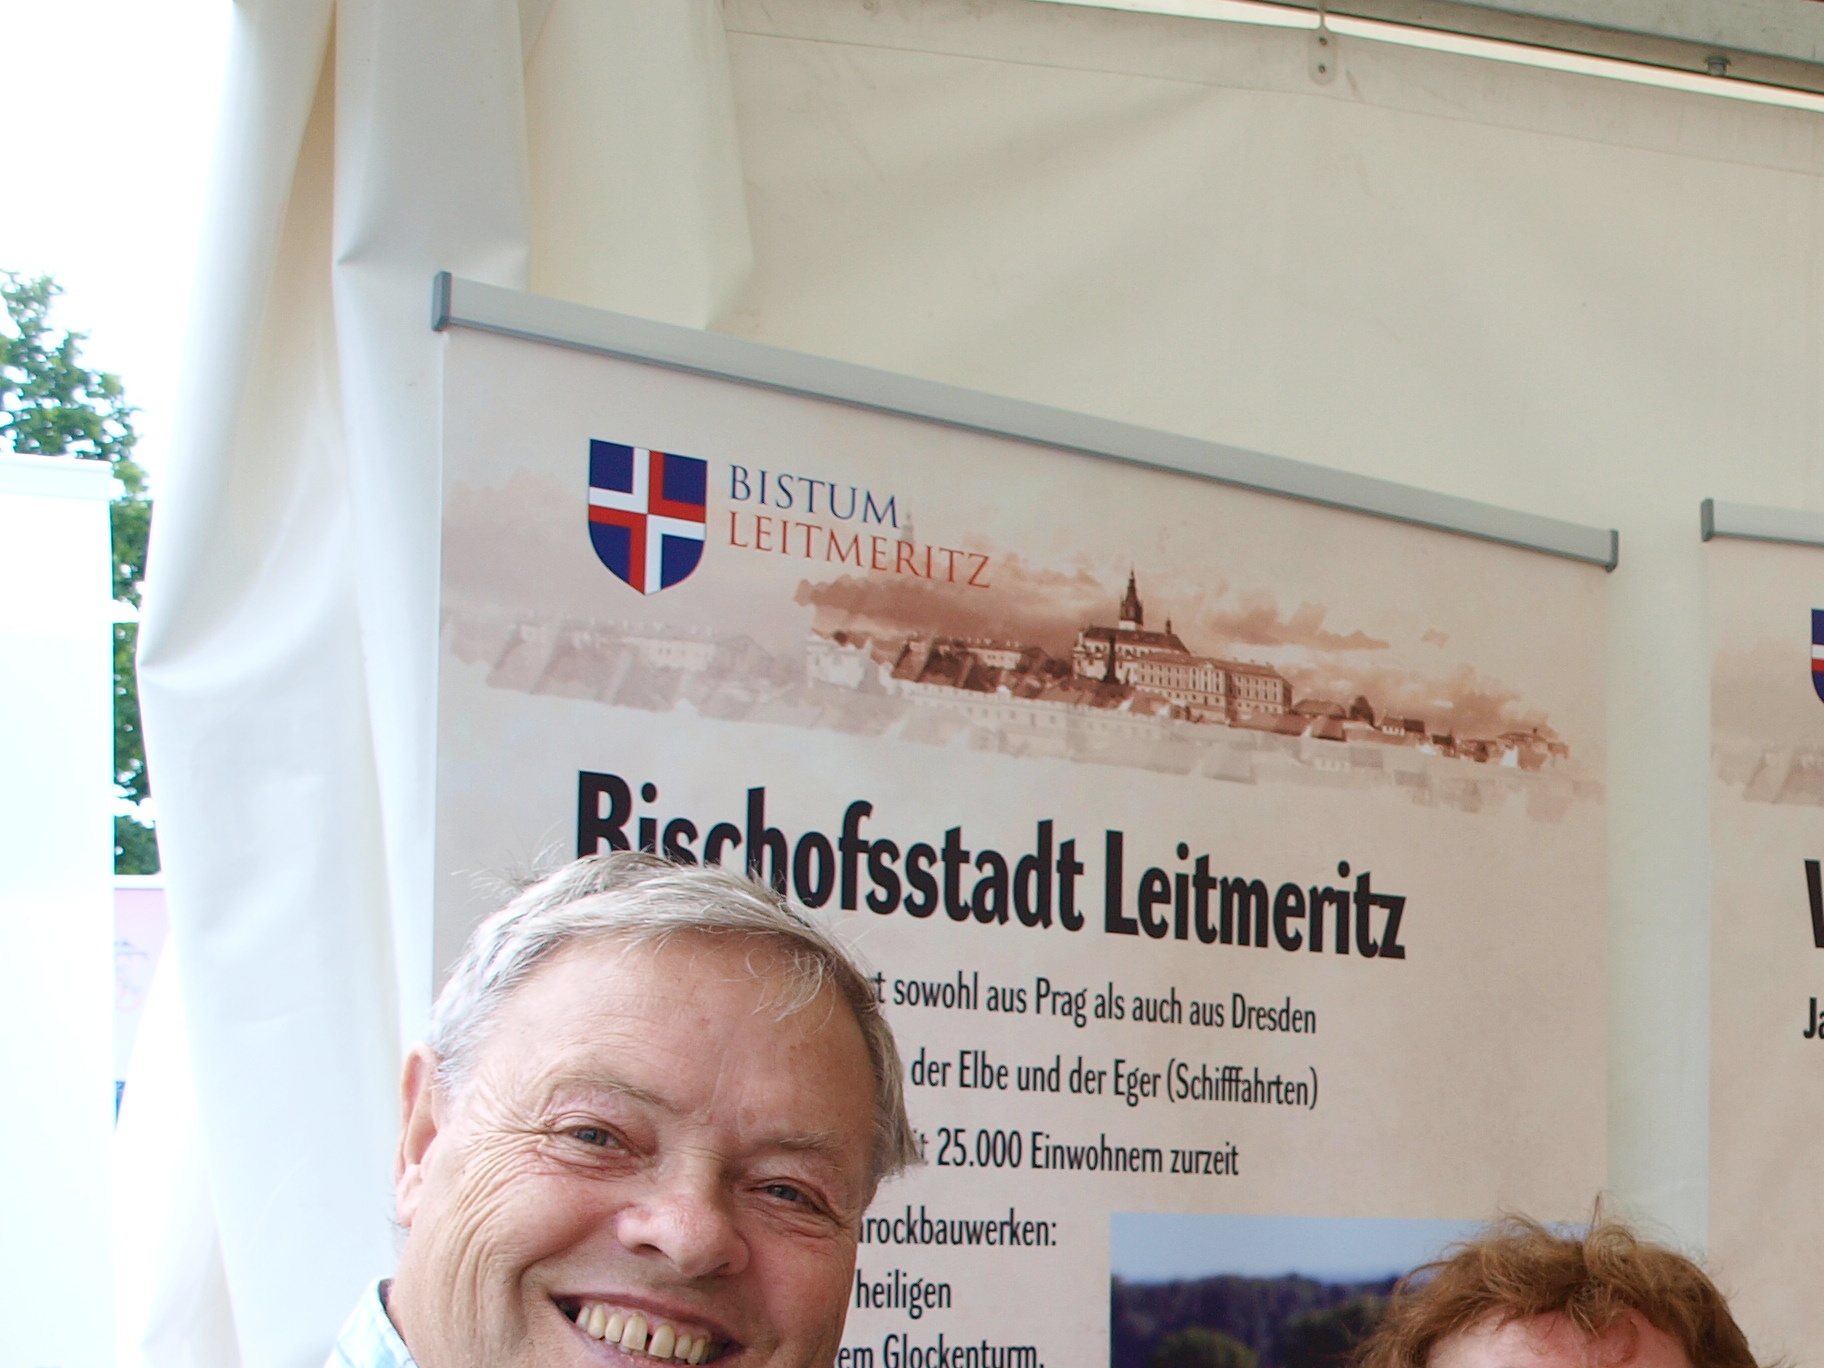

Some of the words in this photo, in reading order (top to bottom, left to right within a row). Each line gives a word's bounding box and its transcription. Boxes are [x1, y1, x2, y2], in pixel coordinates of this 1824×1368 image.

[728, 464, 898, 530] BISTUM
[728, 510, 991, 590] LEITMERITZ
[1104, 830, 1406, 959] Leitmeritz
[894, 972, 977, 1009] sowohl
[986, 986, 1026, 1013] aus
[1036, 977, 1087, 1028] Prag
[1094, 982, 1124, 1020] als
[1132, 986, 1182, 1024] auch
[1189, 1001, 1224, 1027] aus
[1232, 992, 1315, 1033] Dresden
[911, 1047, 951, 1086] der
[959, 1050, 1008, 1089] Elbe
[1017, 1054, 1060, 1092] und
[1069, 1055, 1106, 1094] der
[1114, 1058, 1161, 1107] Eger
[1166, 1058, 1317, 1109] (Schifffahrten)
[937, 1127, 1022, 1167] 25.000
[1031, 1131, 1162, 1172] Einwohnern
[1170, 1141, 1238, 1175] zurzeit
[856, 1269, 951, 1319] heiligen
